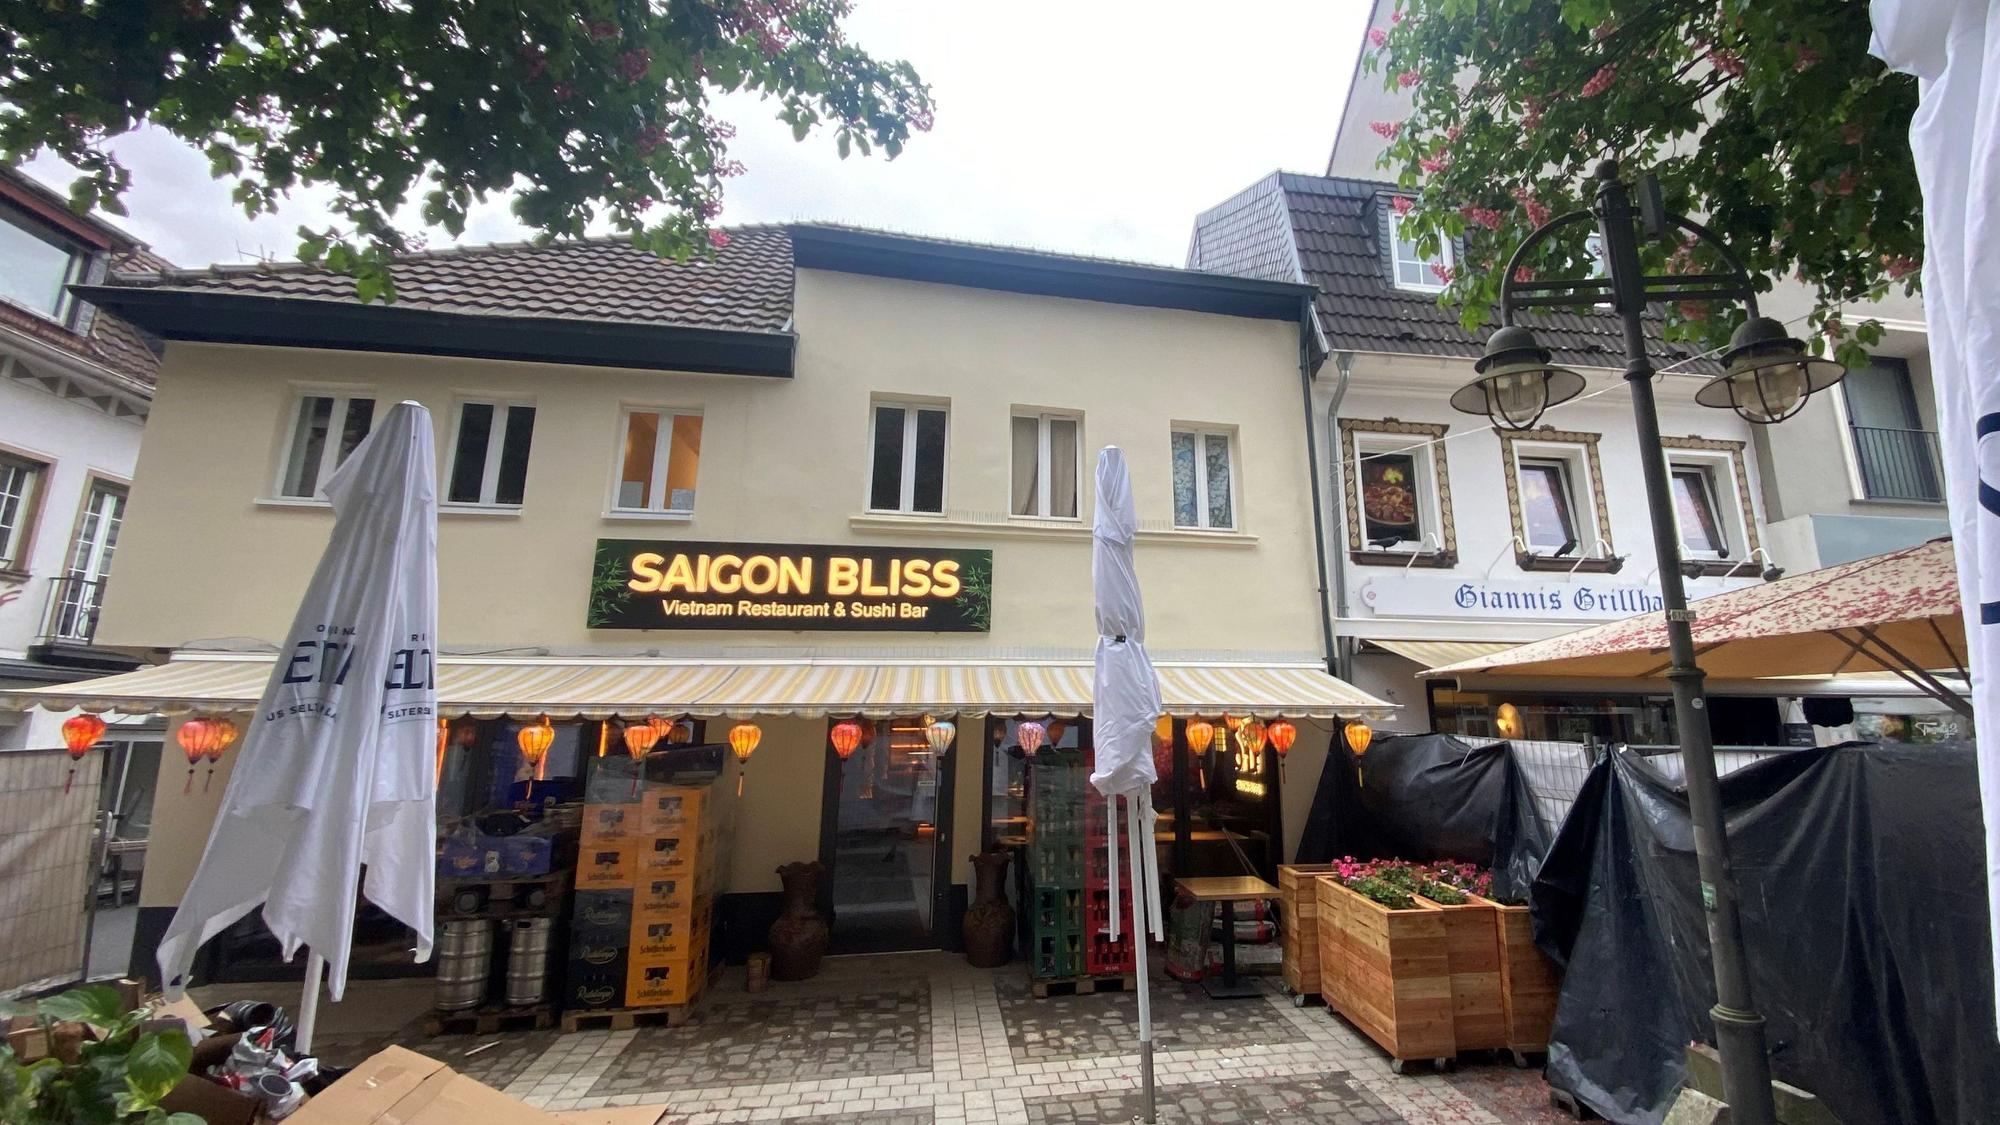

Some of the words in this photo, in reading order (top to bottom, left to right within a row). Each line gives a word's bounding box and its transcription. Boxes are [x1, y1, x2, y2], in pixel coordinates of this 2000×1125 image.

[628, 553, 811, 594] SAIGON
[827, 557, 960, 597] BLISS
[662, 600, 732, 616] Vietnam
[737, 600, 829, 617] Restaurant
[834, 602, 846, 617] &
[850, 602, 896, 618] Sushi
[899, 602, 928, 619] Bar
[1455, 584, 1562, 610] Giannis
[1574, 587, 1691, 612] Grillha
